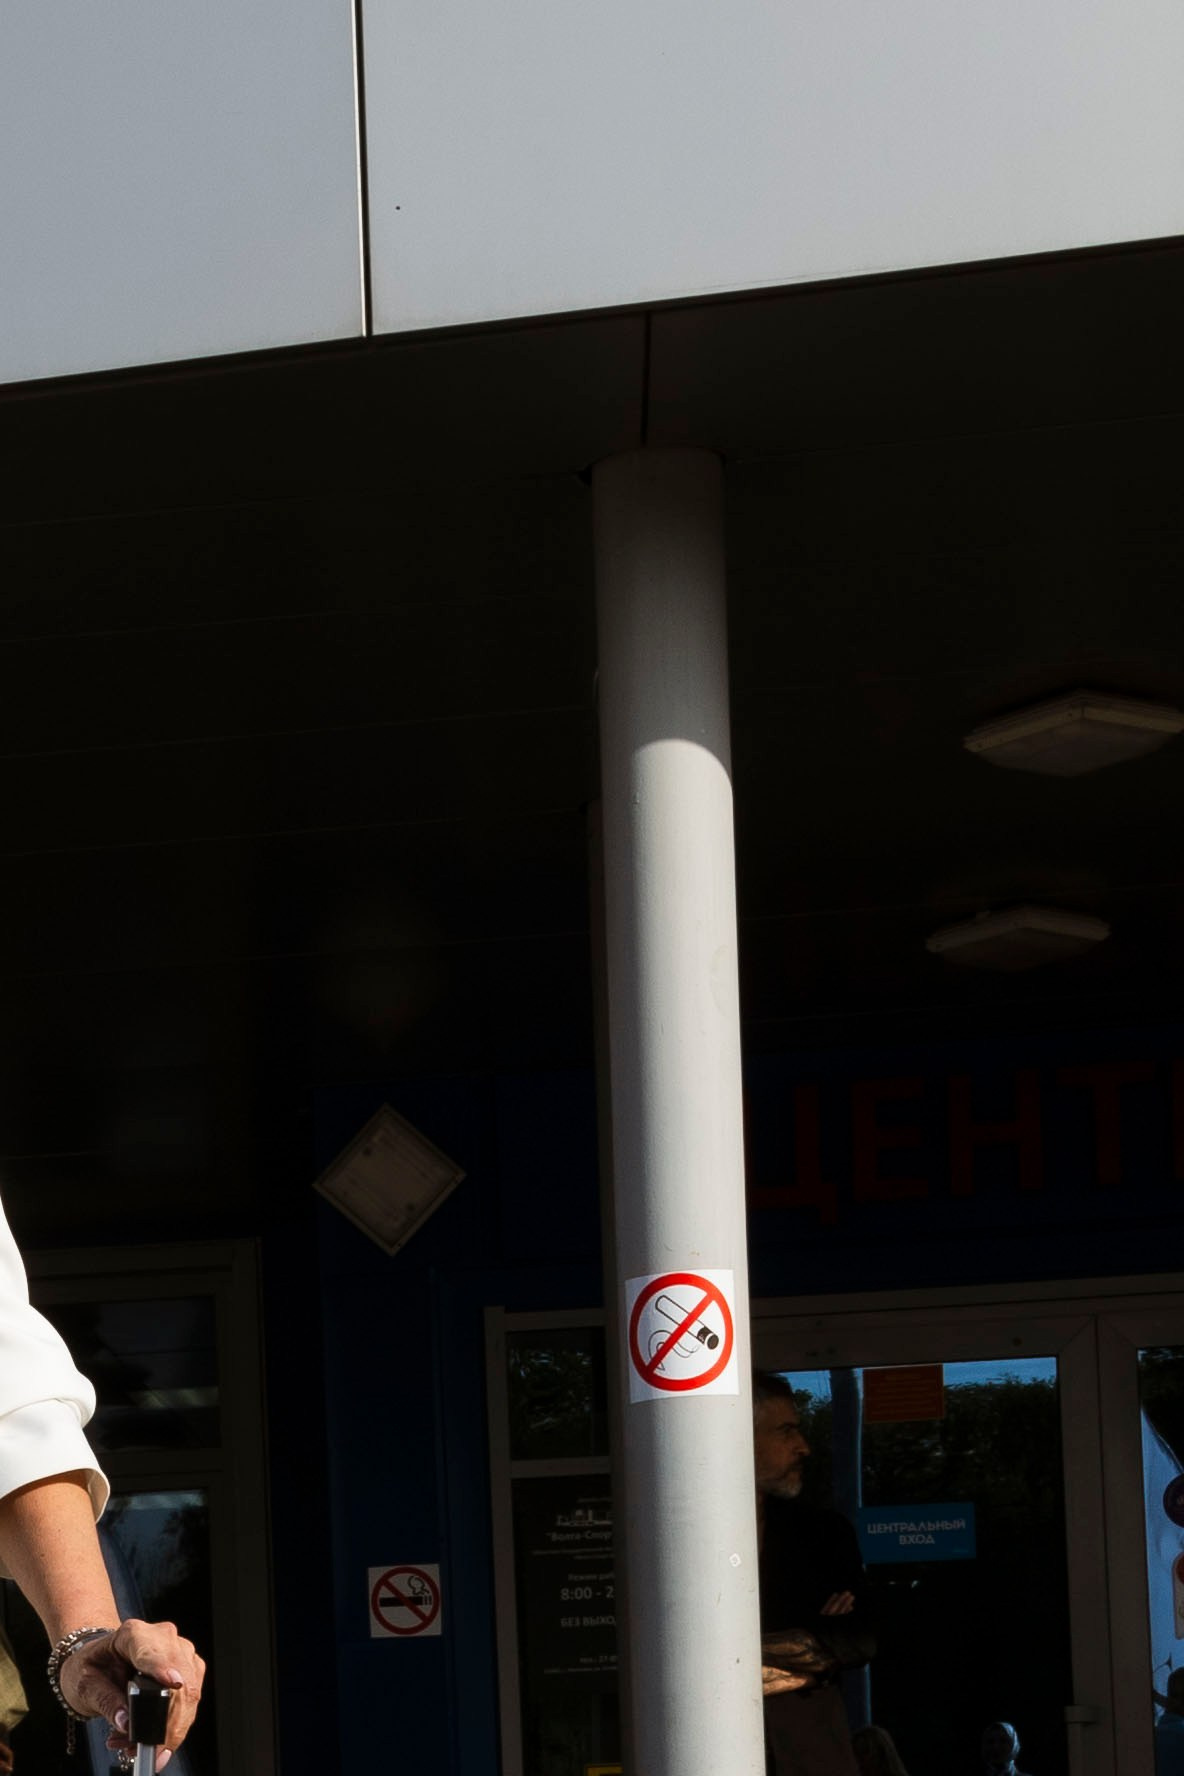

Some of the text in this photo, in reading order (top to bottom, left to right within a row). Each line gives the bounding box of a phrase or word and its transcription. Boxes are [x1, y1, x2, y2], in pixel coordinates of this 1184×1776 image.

[867, 1518, 966, 1535] ЦЕНТРАЛЬНЫЙ
[899, 1534, 935, 1545] ВХОД
[560, 1586, 592, 1600] 8:00
[605, 1585, 614, 1599] 2
[582, 1615, 616, 1627] ВЫХО
